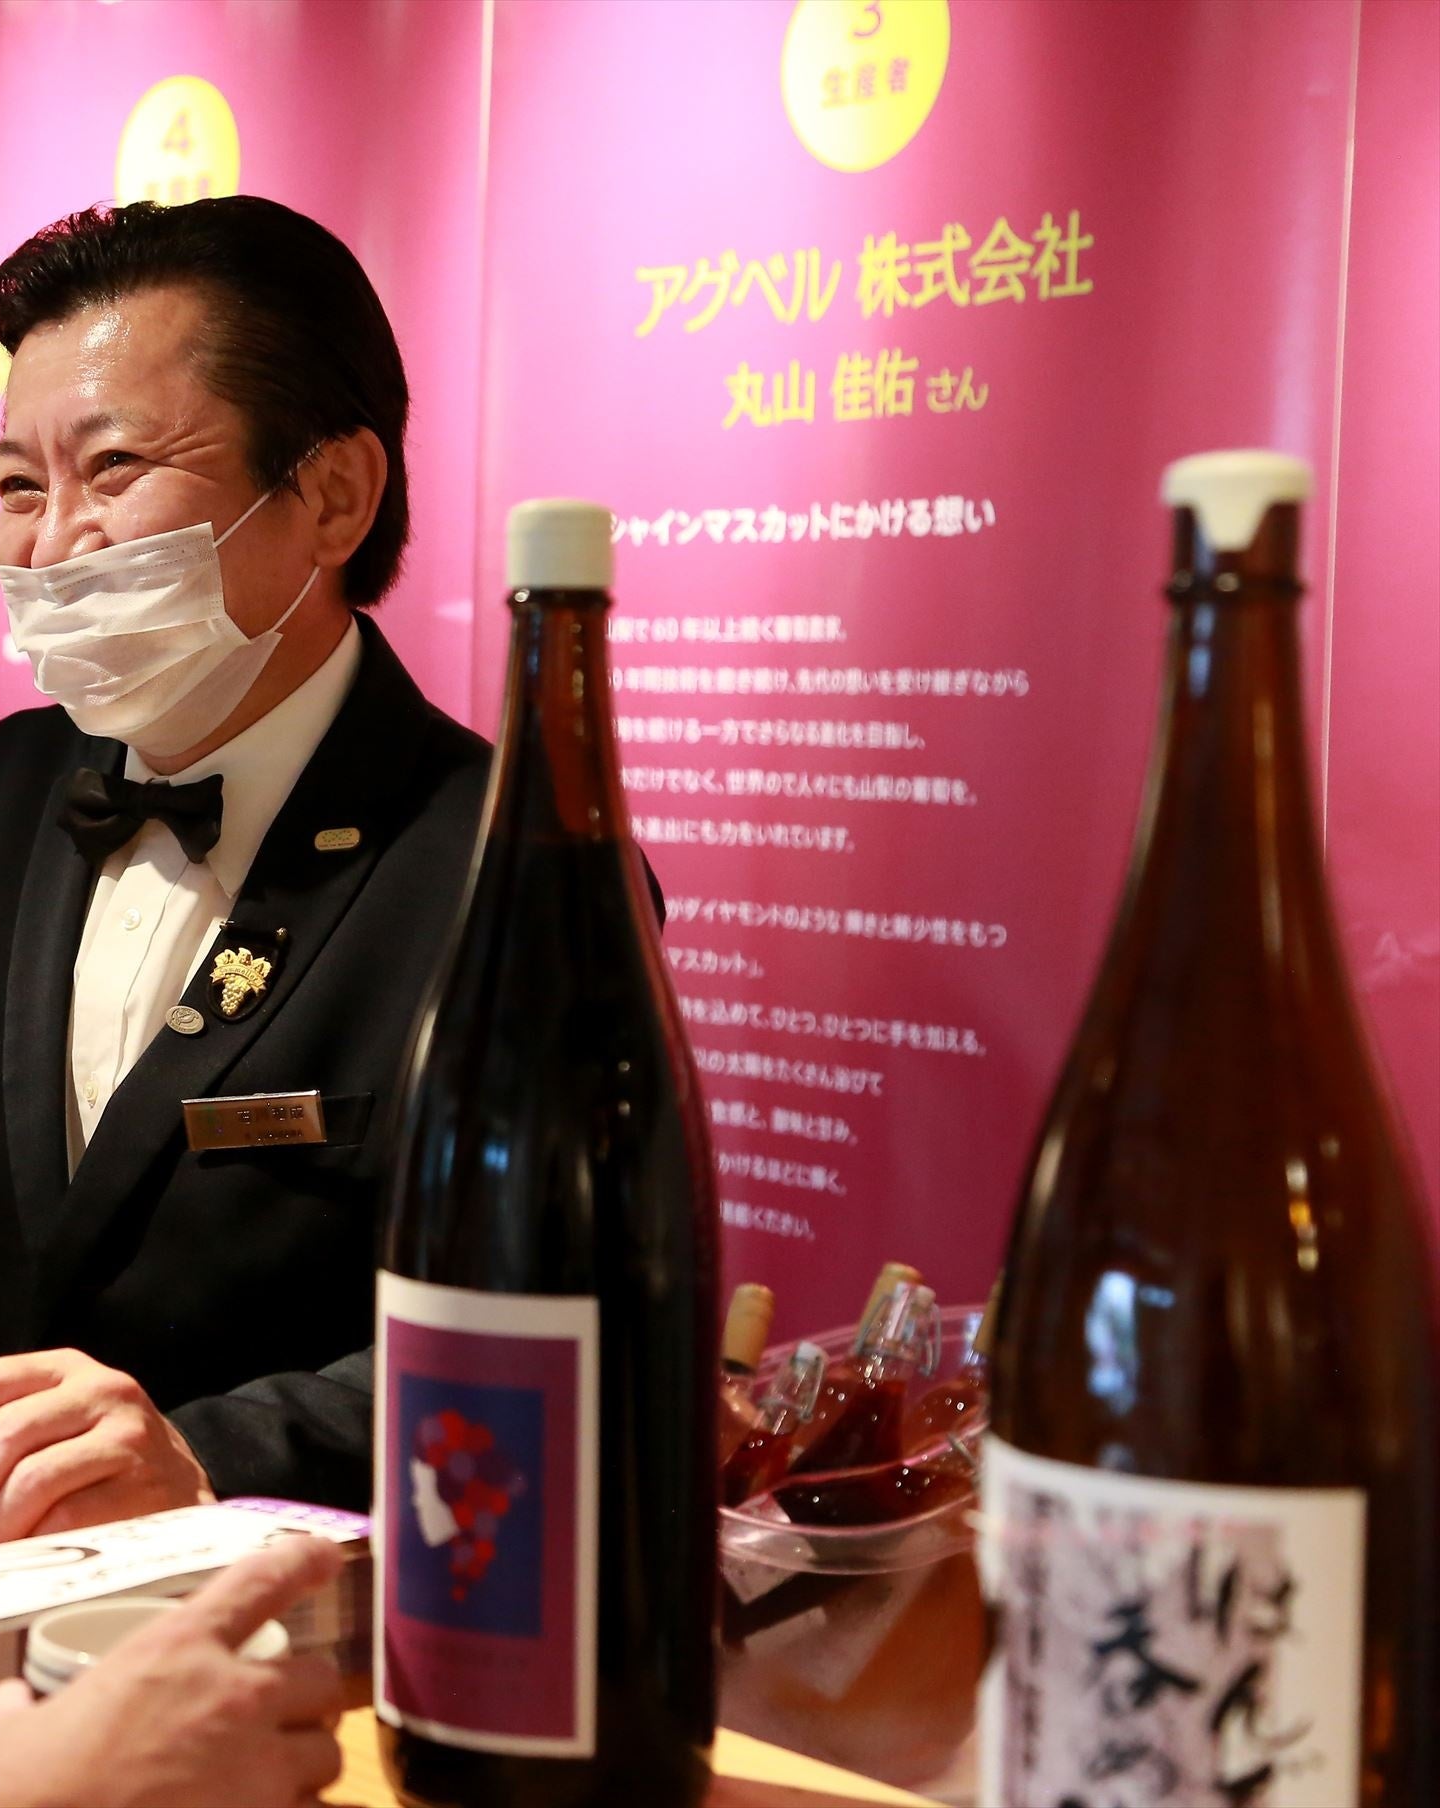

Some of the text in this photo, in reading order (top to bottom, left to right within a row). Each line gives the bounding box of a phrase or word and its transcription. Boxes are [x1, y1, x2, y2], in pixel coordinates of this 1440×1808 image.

[162, 109, 194, 157] 4
[634, 209, 1095, 337] アグベル 株式会社
[722, 347, 989, 429] 丸山 佳佑 さん
[610, 495, 996, 546] シャインマスカットにかける想い
